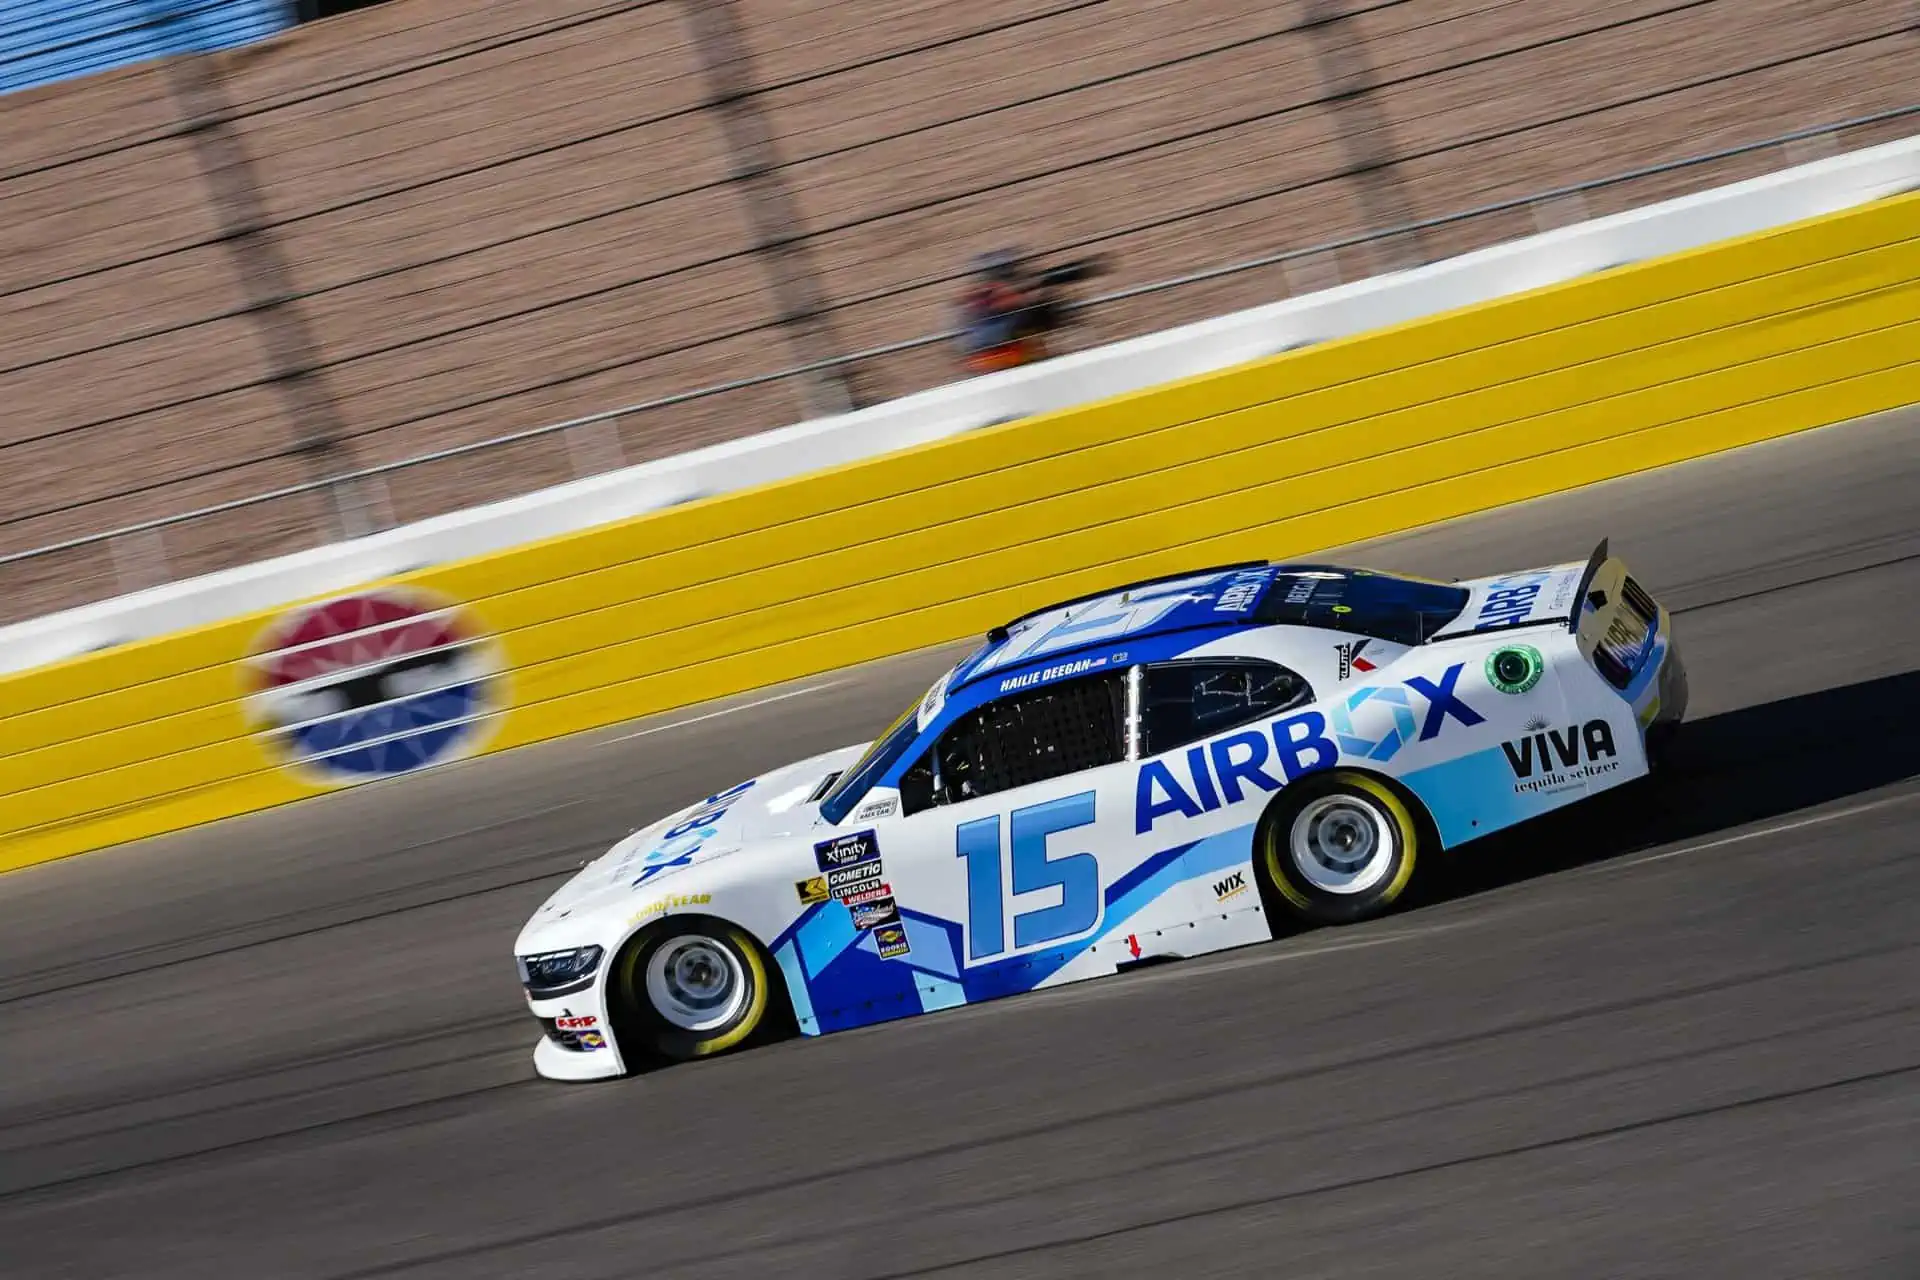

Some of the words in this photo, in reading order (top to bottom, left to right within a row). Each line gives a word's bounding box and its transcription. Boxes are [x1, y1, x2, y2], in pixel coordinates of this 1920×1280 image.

[1000, 670, 1040, 693] HAILIE
[1042, 658, 1092, 682] DEEGAN
[1135, 661, 1488, 836] AIRBOX
[1500, 718, 1617, 779] VIVA
[1514, 771, 1566, 793] tequila
[1569, 760, 1620, 779] seltzer
[826, 841, 868, 863] xfinity
[829, 862, 881, 885] COMETIC
[834, 879, 880, 898] LINCOLN
[956, 789, 1099, 961] 15
[1212, 871, 1246, 898] WIX
[627, 893, 713, 927] OODYEAR
